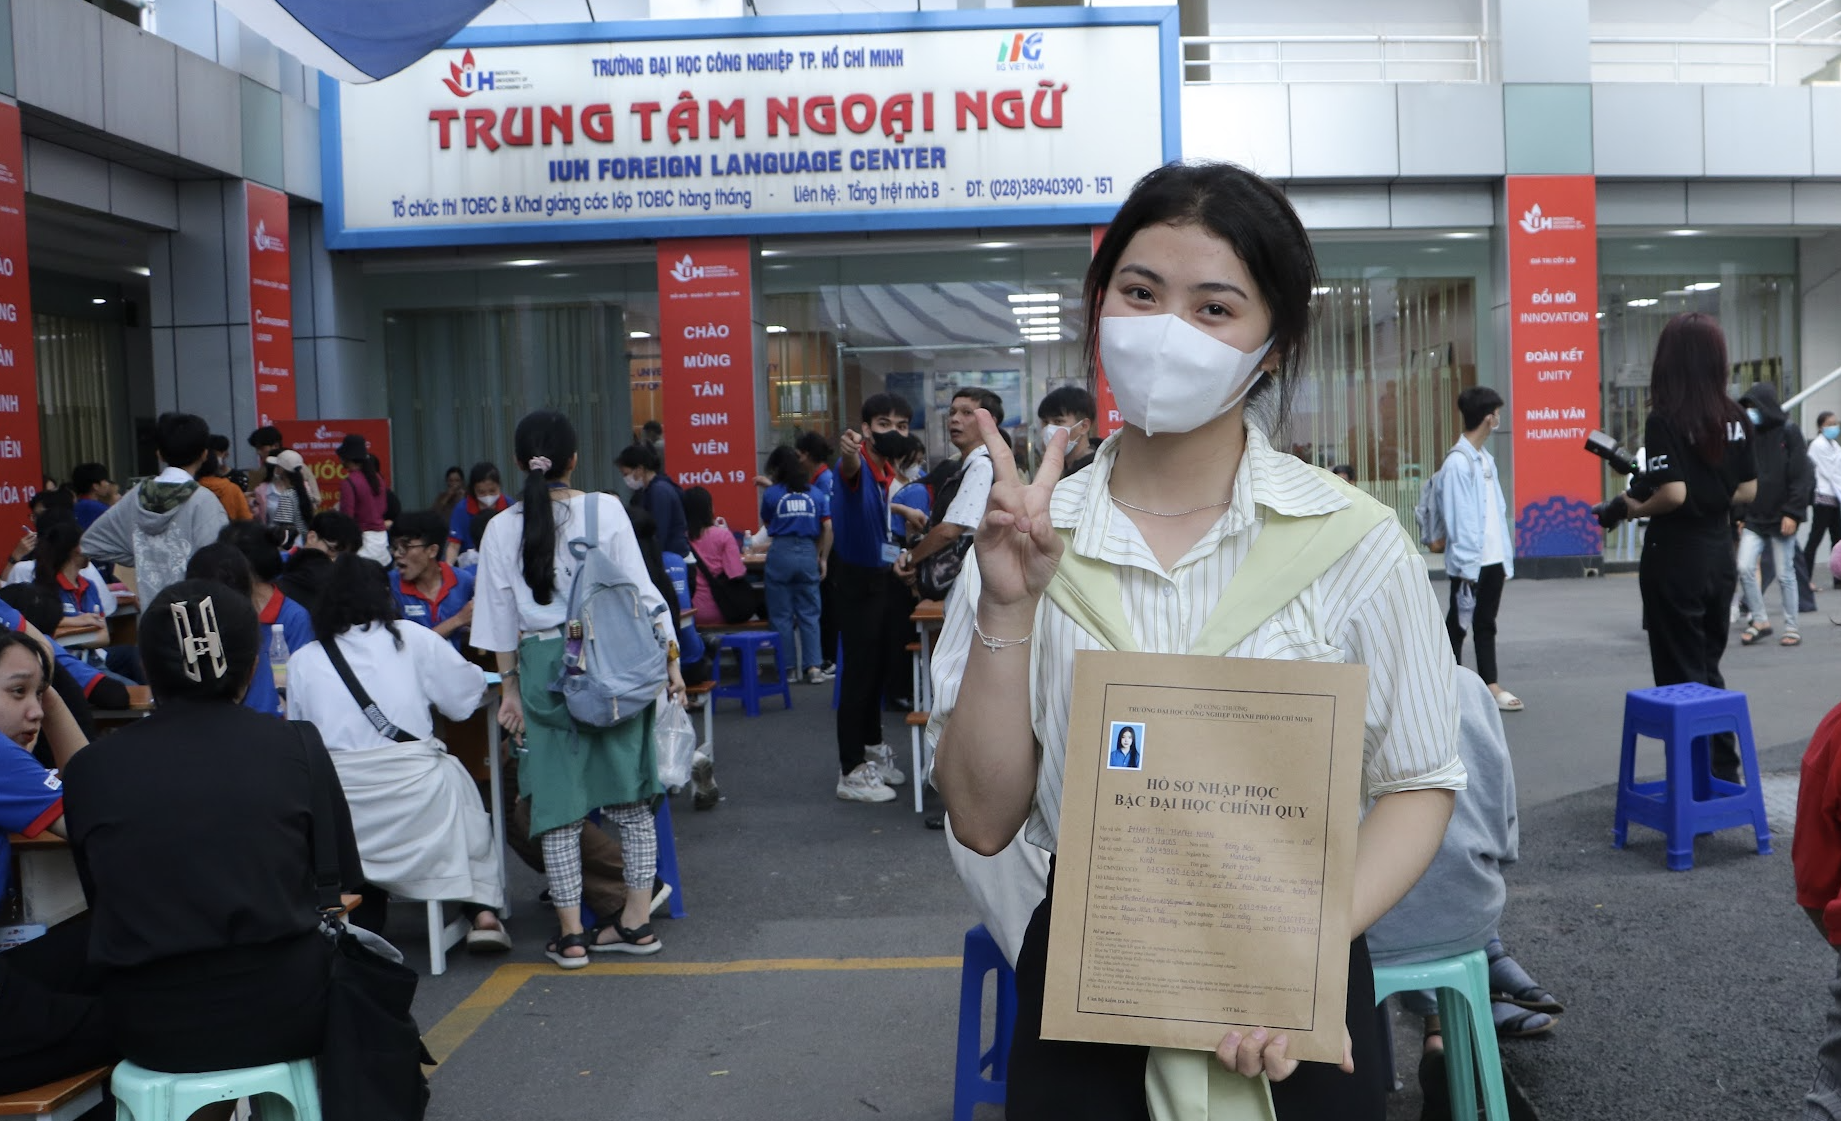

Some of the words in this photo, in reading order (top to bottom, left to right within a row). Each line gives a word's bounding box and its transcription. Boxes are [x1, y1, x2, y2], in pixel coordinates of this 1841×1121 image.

[592, 53, 643, 76] TRƯỜNG
[650, 56, 671, 77] ĐẠI
[676, 55, 701, 77] HỌC
[707, 51, 741, 72] CÔNG
[747, 49, 793, 73] NGHIỆP
[800, 51, 817, 69] TP.
[869, 48, 903, 67] MINH
[429, 103, 614, 151] TRUNG
[630, 90, 745, 144] TÂM
[767, 92, 934, 143] NGOẠI
[955, 79, 1068, 131] NGỮ
[549, 158, 590, 181] IUH
[598, 155, 702, 180] FOREIGN
[711, 149, 842, 176] LANGUAGE
[850, 147, 946, 171] CENTER
[794, 185, 818, 203] Liên
[847, 180, 877, 205] Tầng
[881, 181, 902, 203] trệt
[905, 181, 929, 199] nhà
[932, 181, 939, 198] B
[966, 180, 985, 197] ĐT:
[990, 177, 1083, 201] (028)38940390
[408, 199, 439, 217] chức
[461, 196, 497, 215] TOEIC
[502, 196, 510, 213] &
[515, 195, 542, 213] Khai
[546, 192, 581, 217] giảng
[584, 192, 608, 210] các
[612, 191, 632, 212] lớp
[637, 190, 674, 208] TOEIC
[679, 188, 711, 210] hàng
[715, 187, 752, 209] tháng
[1555, 292, 1576, 303] MỚI
[1520, 312, 1589, 323] INNOVATION
[684, 322, 730, 339] CHÀO
[683, 352, 731, 368] MỪNG
[1525, 349, 1558, 362] ĐOÀN
[1561, 347, 1584, 361] KẾT
[1538, 370, 1572, 381] UNITY
[692, 381, 724, 396] TÂN
[690, 413, 728, 426] SINH
[1526, 407, 1559, 420] NHÂN
[1561, 407, 1586, 419] VĂN
[1526, 428, 1586, 439] HUMANITY
[692, 439, 729, 455] VIÊN
[679, 468, 724, 485] KHÓA
[728, 470, 745, 482] 19
[786, 499, 806, 512] IUH
[1147, 776, 1169, 791] HỒ
[1173, 780, 1194, 793] SƠ
[1198, 780, 1241, 798] NHẬP
[1245, 785, 1279, 801] HỌC
[1115, 793, 1146, 809] BẬC
[1150, 796, 1177, 812] ĐẠI
[1182, 798, 1215, 813] HỌC
[1220, 799, 1270, 816] CHÍNH
[1275, 805, 1309, 819] QUY
